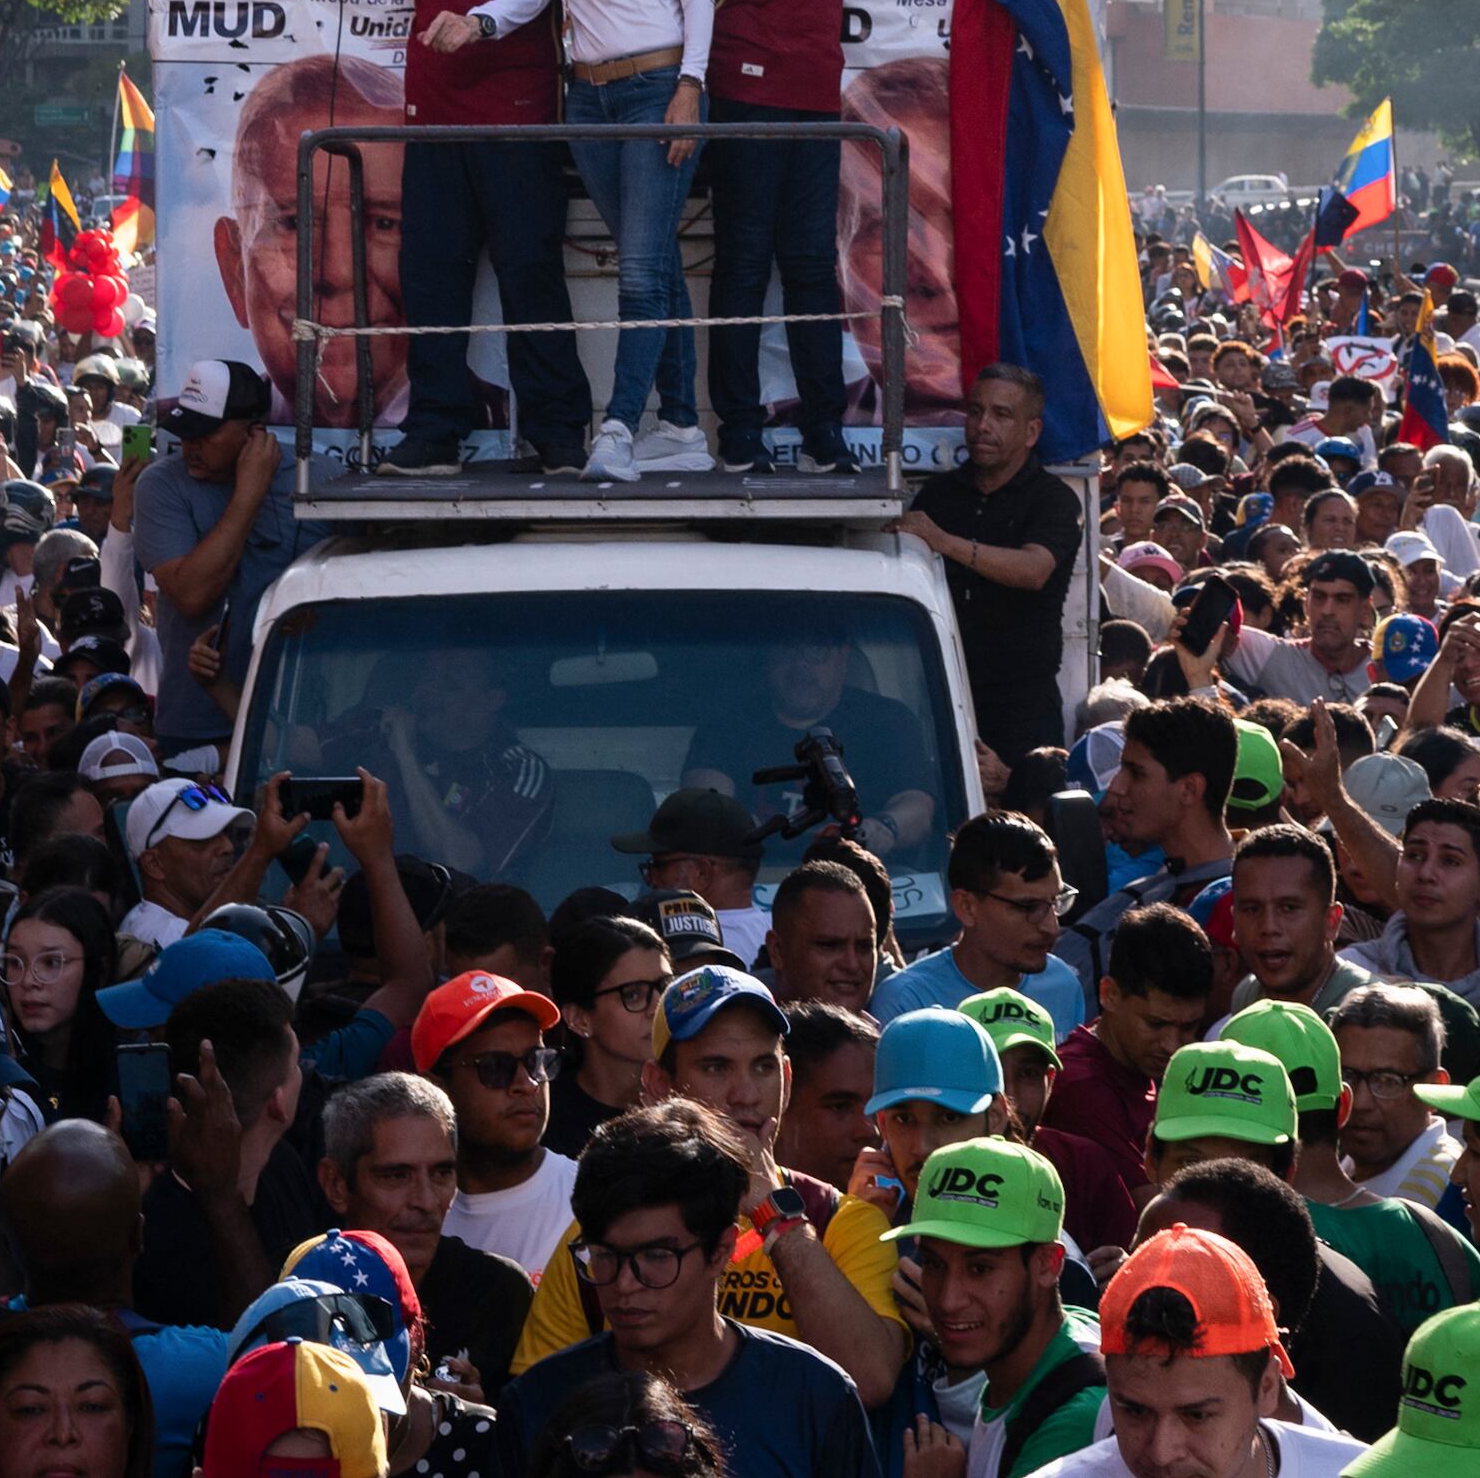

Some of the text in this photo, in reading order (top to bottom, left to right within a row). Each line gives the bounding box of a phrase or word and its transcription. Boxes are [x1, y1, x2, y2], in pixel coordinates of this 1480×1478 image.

[168, 0, 286, 39] MUD
[983, 1002, 1042, 1026] JDC
[1186, 1067, 1264, 1096] JDC
[928, 1167, 1004, 1199] JDC
[1403, 1364, 1467, 1407] DC
